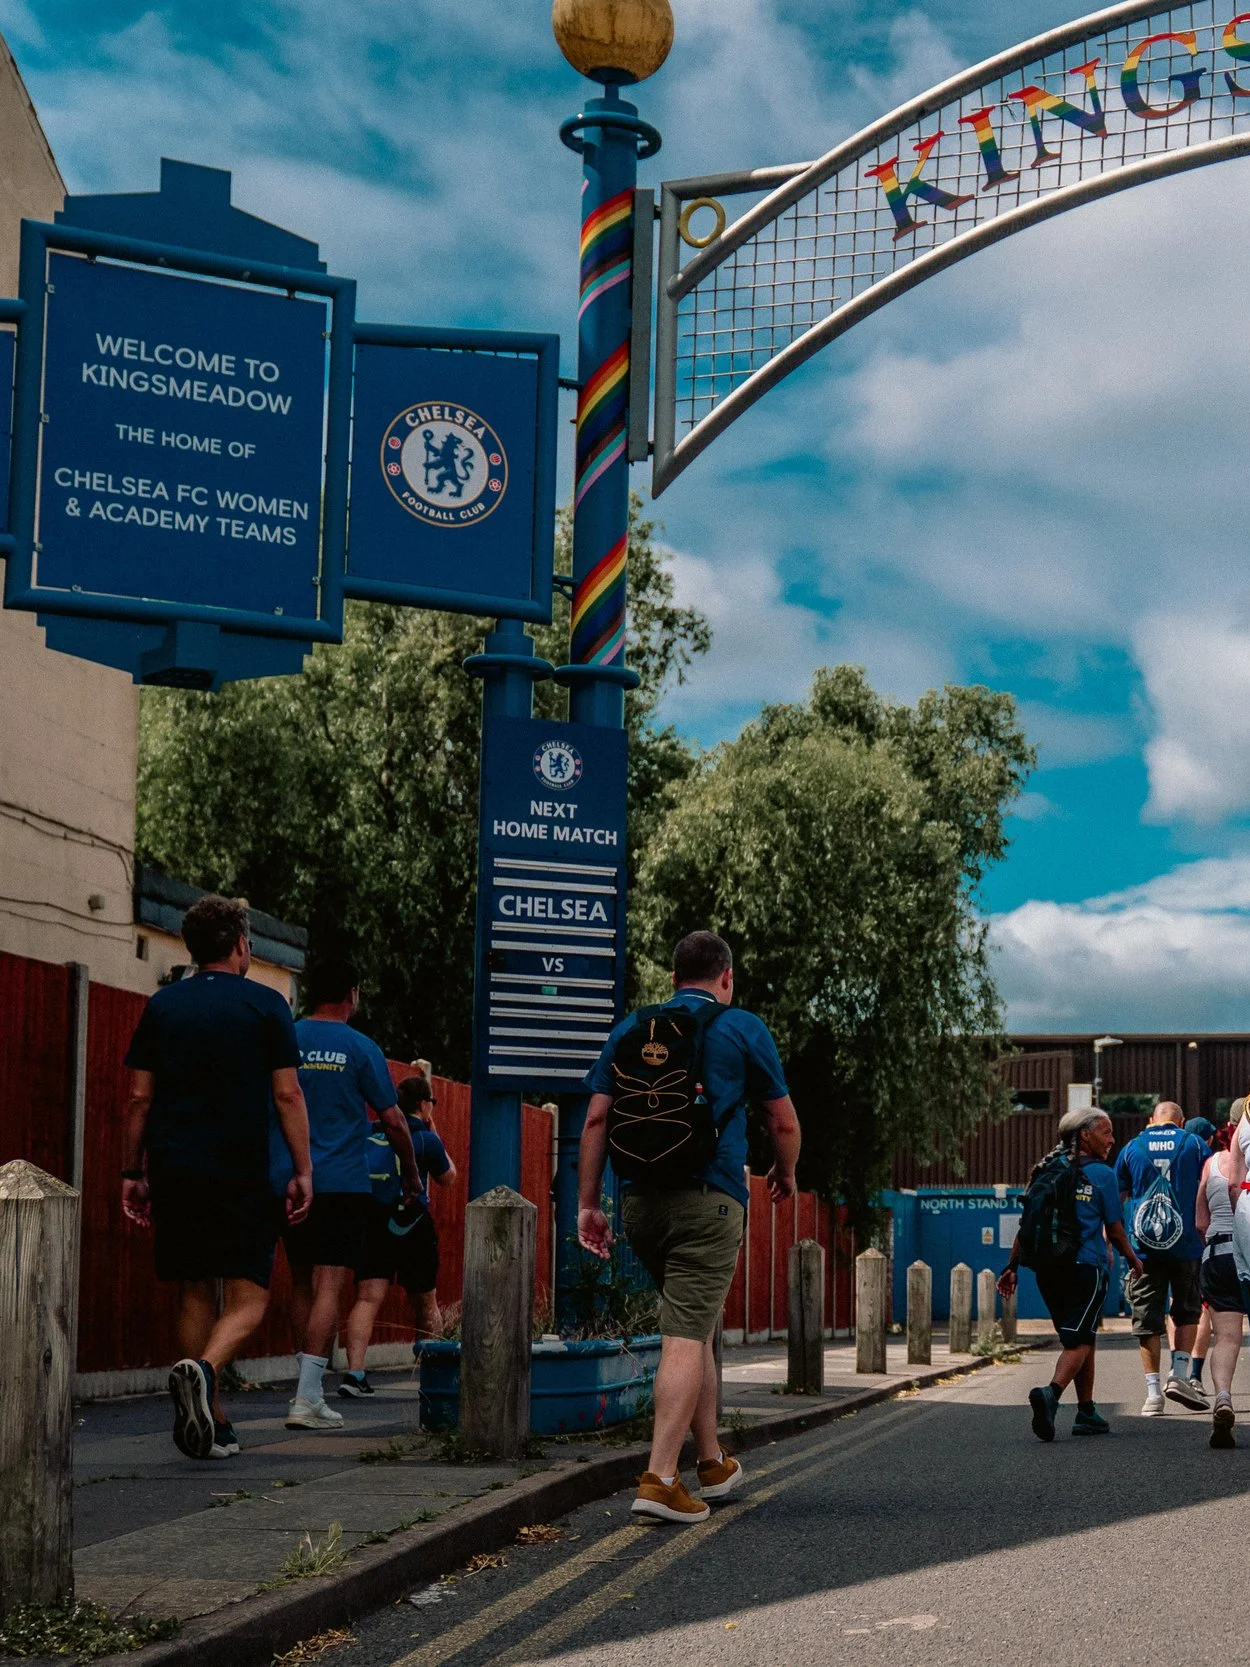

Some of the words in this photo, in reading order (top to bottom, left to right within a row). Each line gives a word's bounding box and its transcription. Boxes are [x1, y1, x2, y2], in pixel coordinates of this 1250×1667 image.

[95, 333, 236, 376] WELCOME
[243, 357, 280, 382] TO
[82, 362, 293, 415] KINGSMEADOW
[405, 405, 486, 440] CHELSEA
[115, 423, 155, 445] THE
[161, 430, 222, 455] HOME
[228, 441, 256, 459] OF
[54, 467, 169, 501] CHELSEA
[177, 484, 209, 506] FC
[216, 489, 309, 521] WOMEN
[402, 491, 455, 520] FOOTBALL
[460, 502, 486, 519] CLUB
[65, 497, 81, 517] &
[88, 500, 210, 533] ACADEMY
[216, 516, 297, 546] TEAMS
[541, 741, 574, 754] CHELSEA
[530, 800, 578, 819] NEXT
[493, 820, 548, 839] HOME
[553, 823, 618, 845] MATCH
[498, 894, 608, 922] CHELSEA
[542, 957, 565, 973] VS
[307, 1050, 347, 1064] CLUB
[1148, 1140, 1175, 1151] WHO
[920, 1198, 964, 1210] NORTH
[968, 1198, 1008, 1210] STAND
